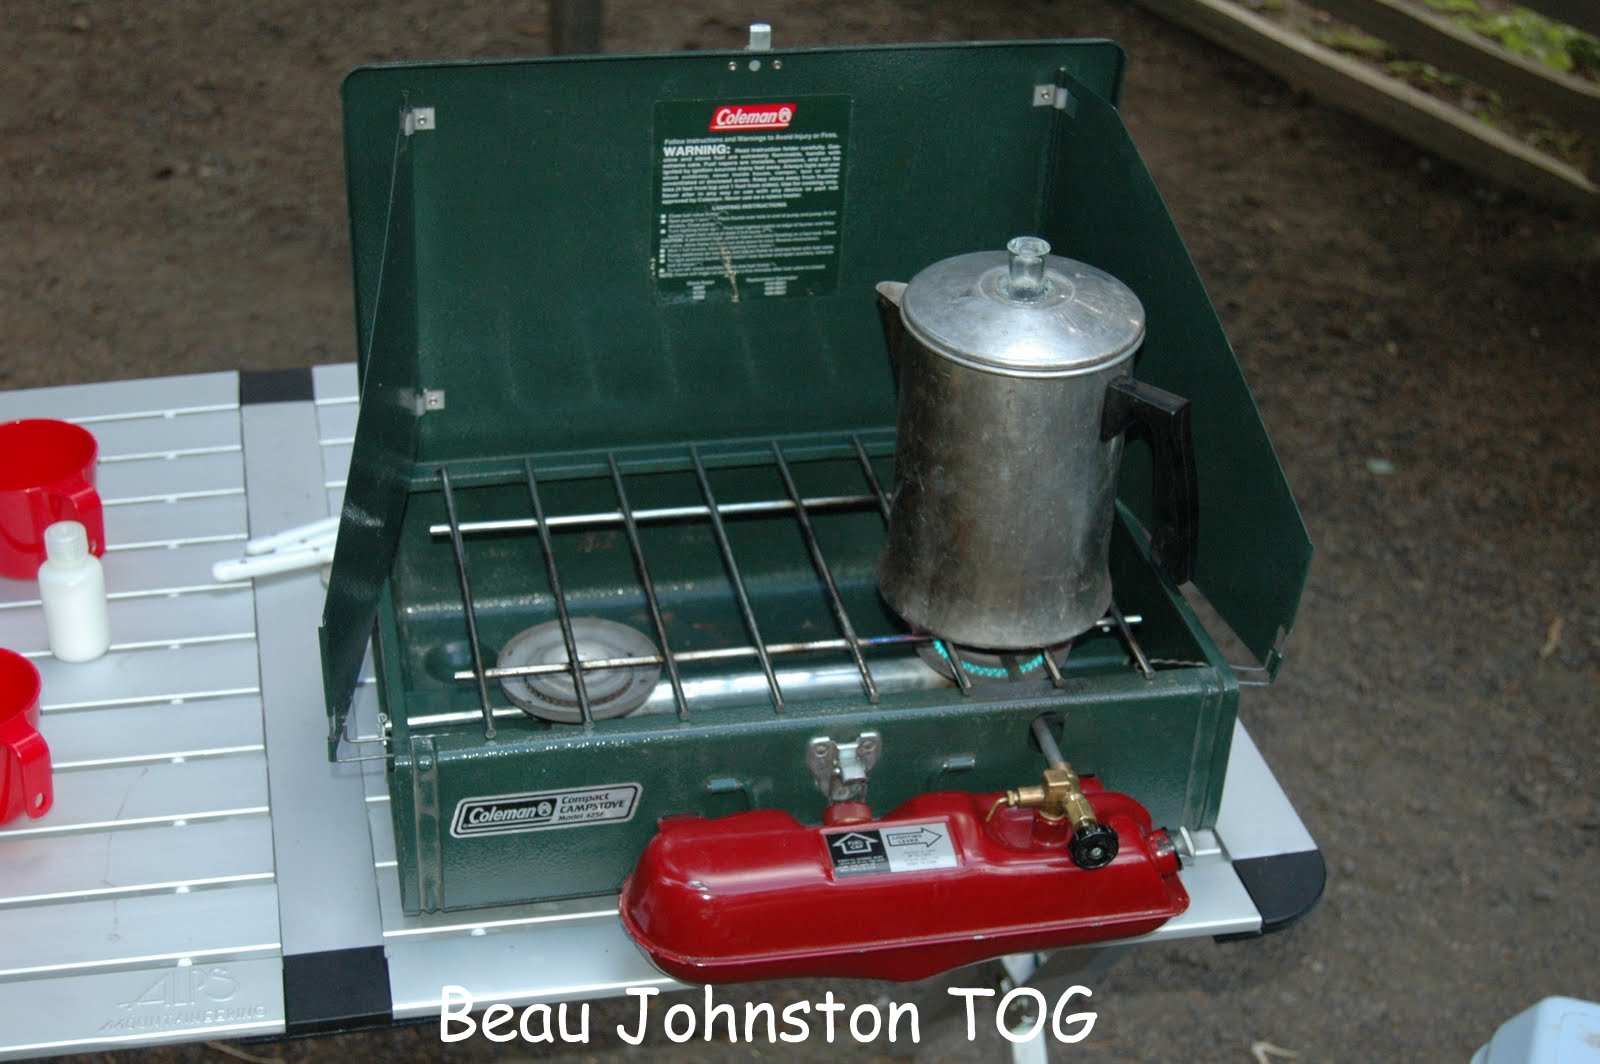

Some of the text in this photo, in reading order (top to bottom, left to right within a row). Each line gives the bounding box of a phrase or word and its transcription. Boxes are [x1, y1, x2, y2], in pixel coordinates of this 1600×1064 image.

[716, 108, 776, 126] Coleman
[663, 144, 731, 156] WARNING:
[562, 792, 609, 804] Compact
[560, 800, 624, 814] CAMPSTOVE
[468, 805, 537, 825] Coleman
